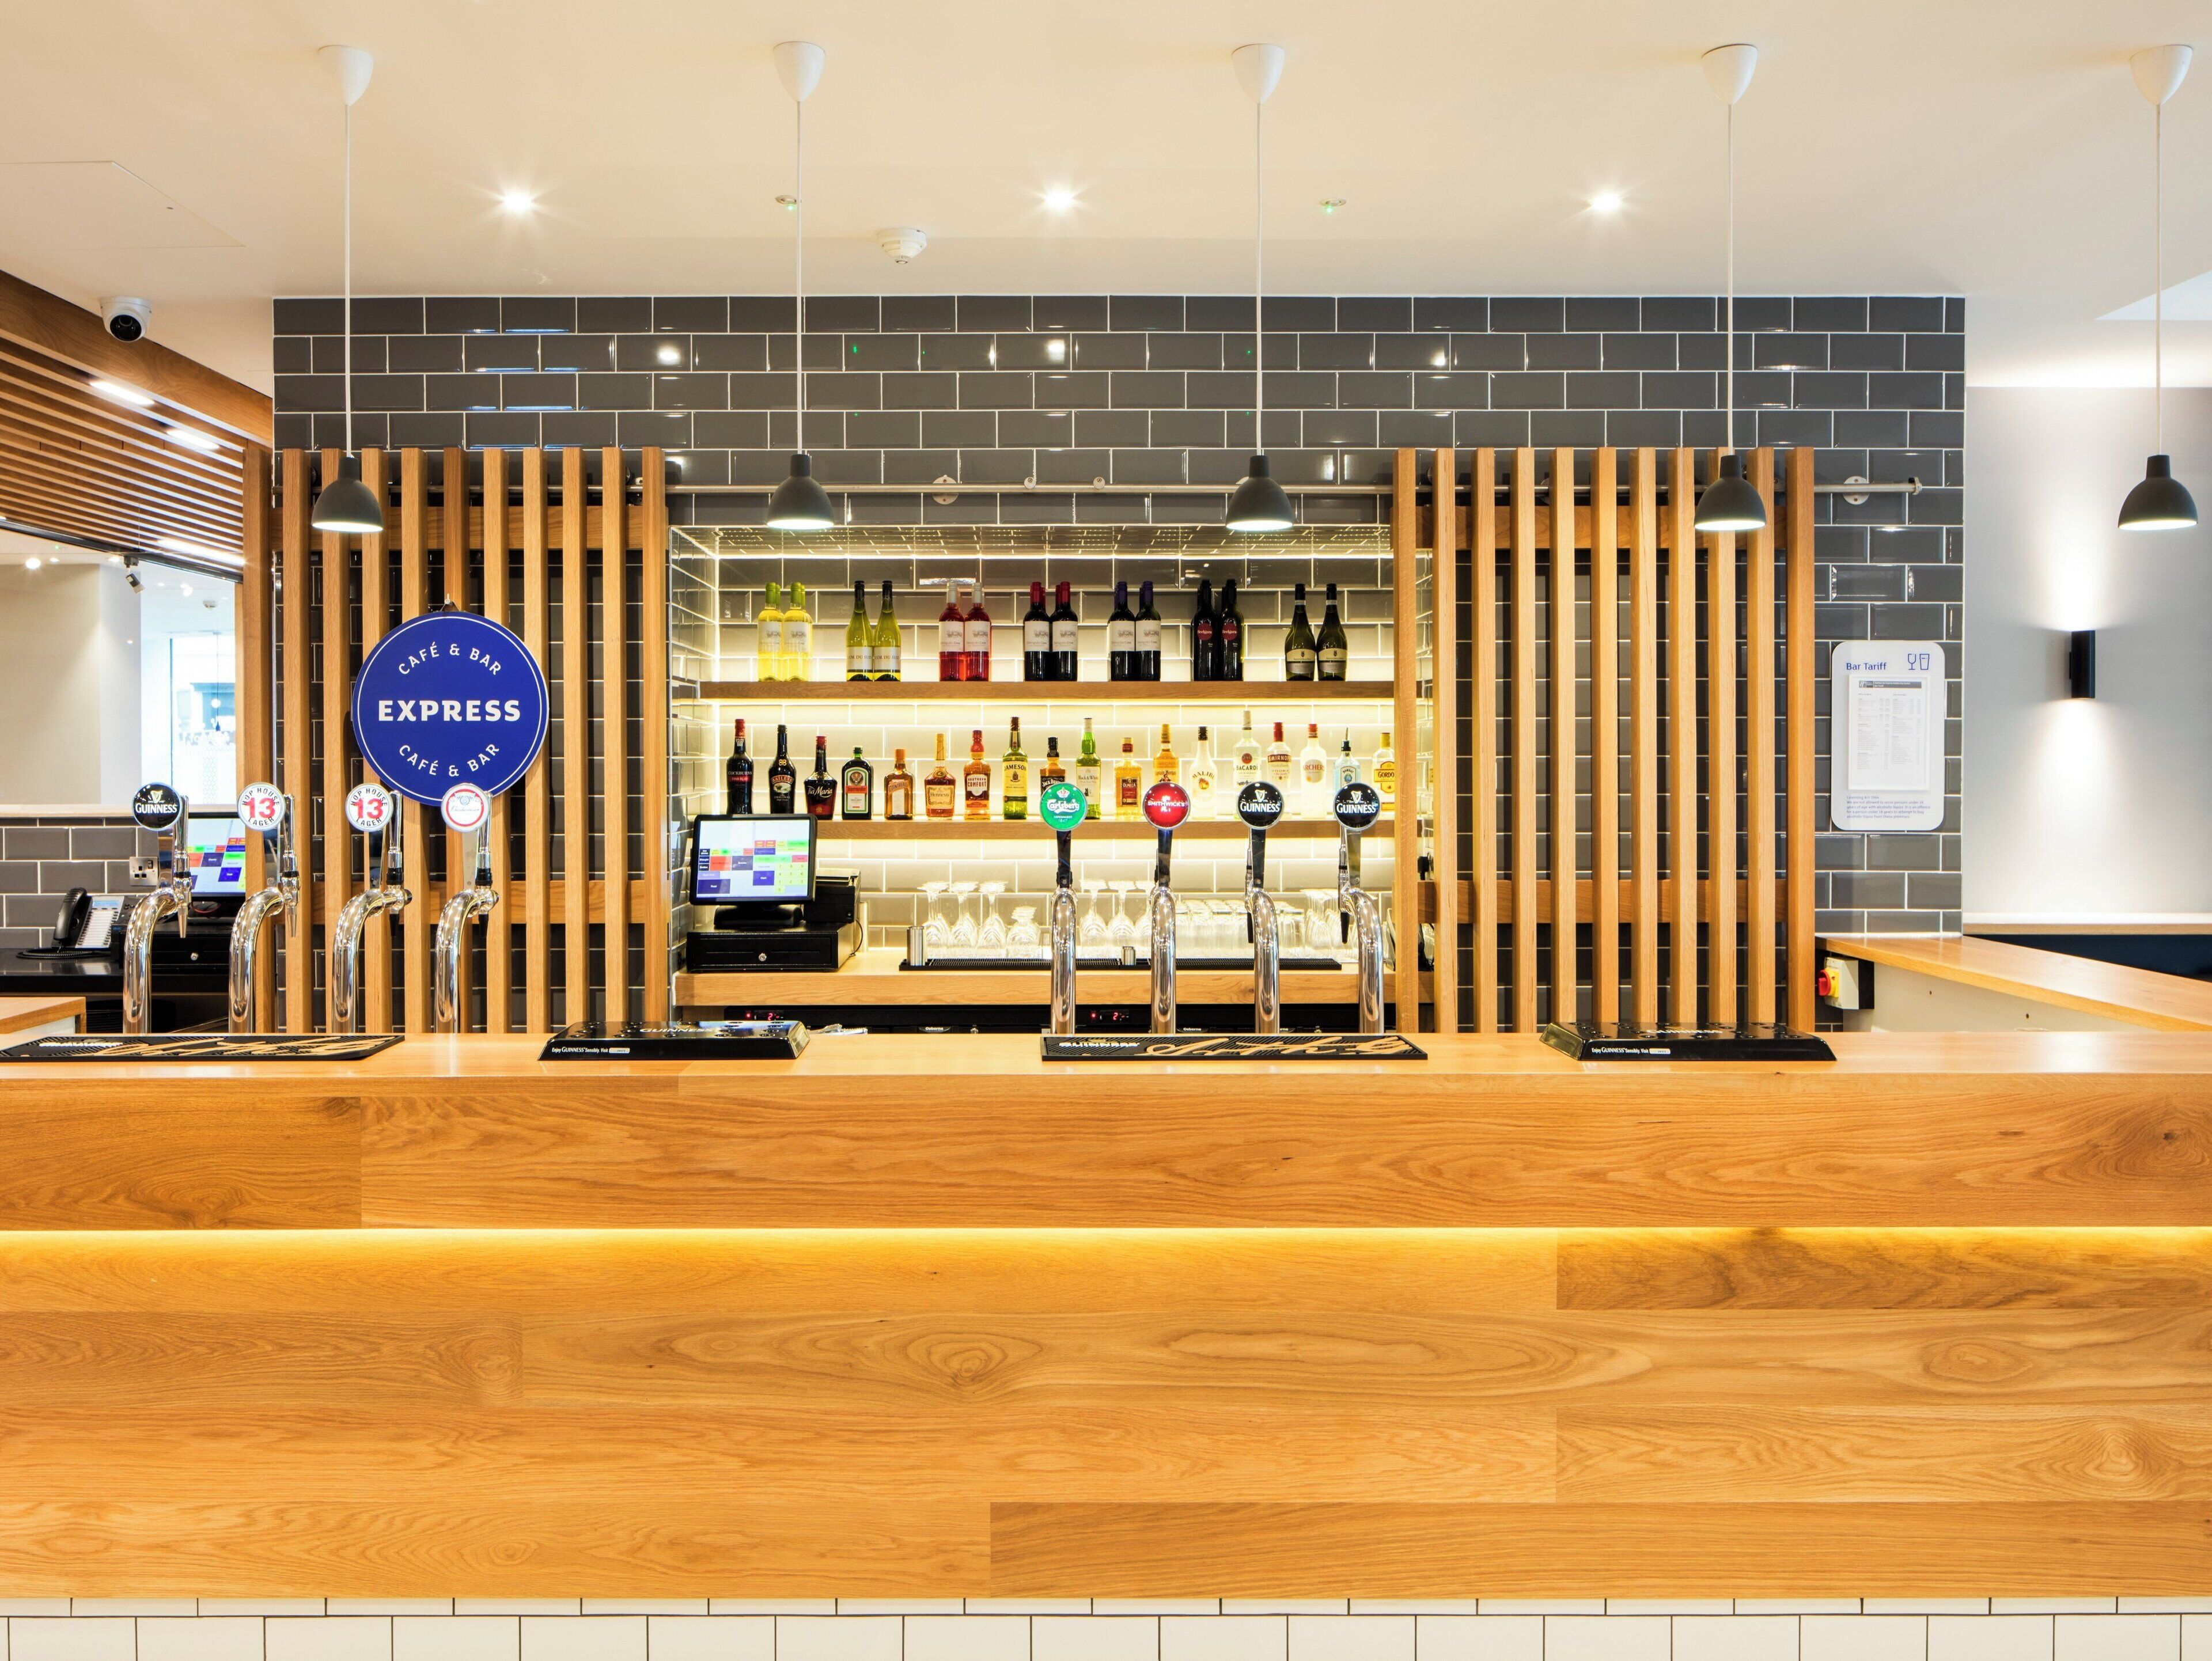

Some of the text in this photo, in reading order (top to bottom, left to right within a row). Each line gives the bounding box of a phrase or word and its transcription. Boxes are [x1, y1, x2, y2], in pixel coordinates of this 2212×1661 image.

[399, 642, 501, 675] CAFÉ & BAR
[1863, 662, 1887, 670] Tariff
[378, 700, 520, 722] EXPRESS
[399, 744, 499, 778] CAFÉ & BAR
[814, 786, 833, 796] Maria
[242, 787, 280, 806] HOP HOUSE
[350, 788, 388, 806] HOP HOUSE
[135, 803, 177, 813] GUINNESS
[244, 797, 275, 818] 13
[353, 797, 383, 819] 13
[1047, 799, 1080, 814] Carlsberg
[1240, 802, 1280, 812] GUINNESS
[1337, 803, 1376, 813] GUINNESS
[248, 817, 274, 826] LAGER
[356, 817, 381, 826] LAGER
[768, 1012, 774, 1021] 2
[1113, 1012, 1118, 1020] 2
